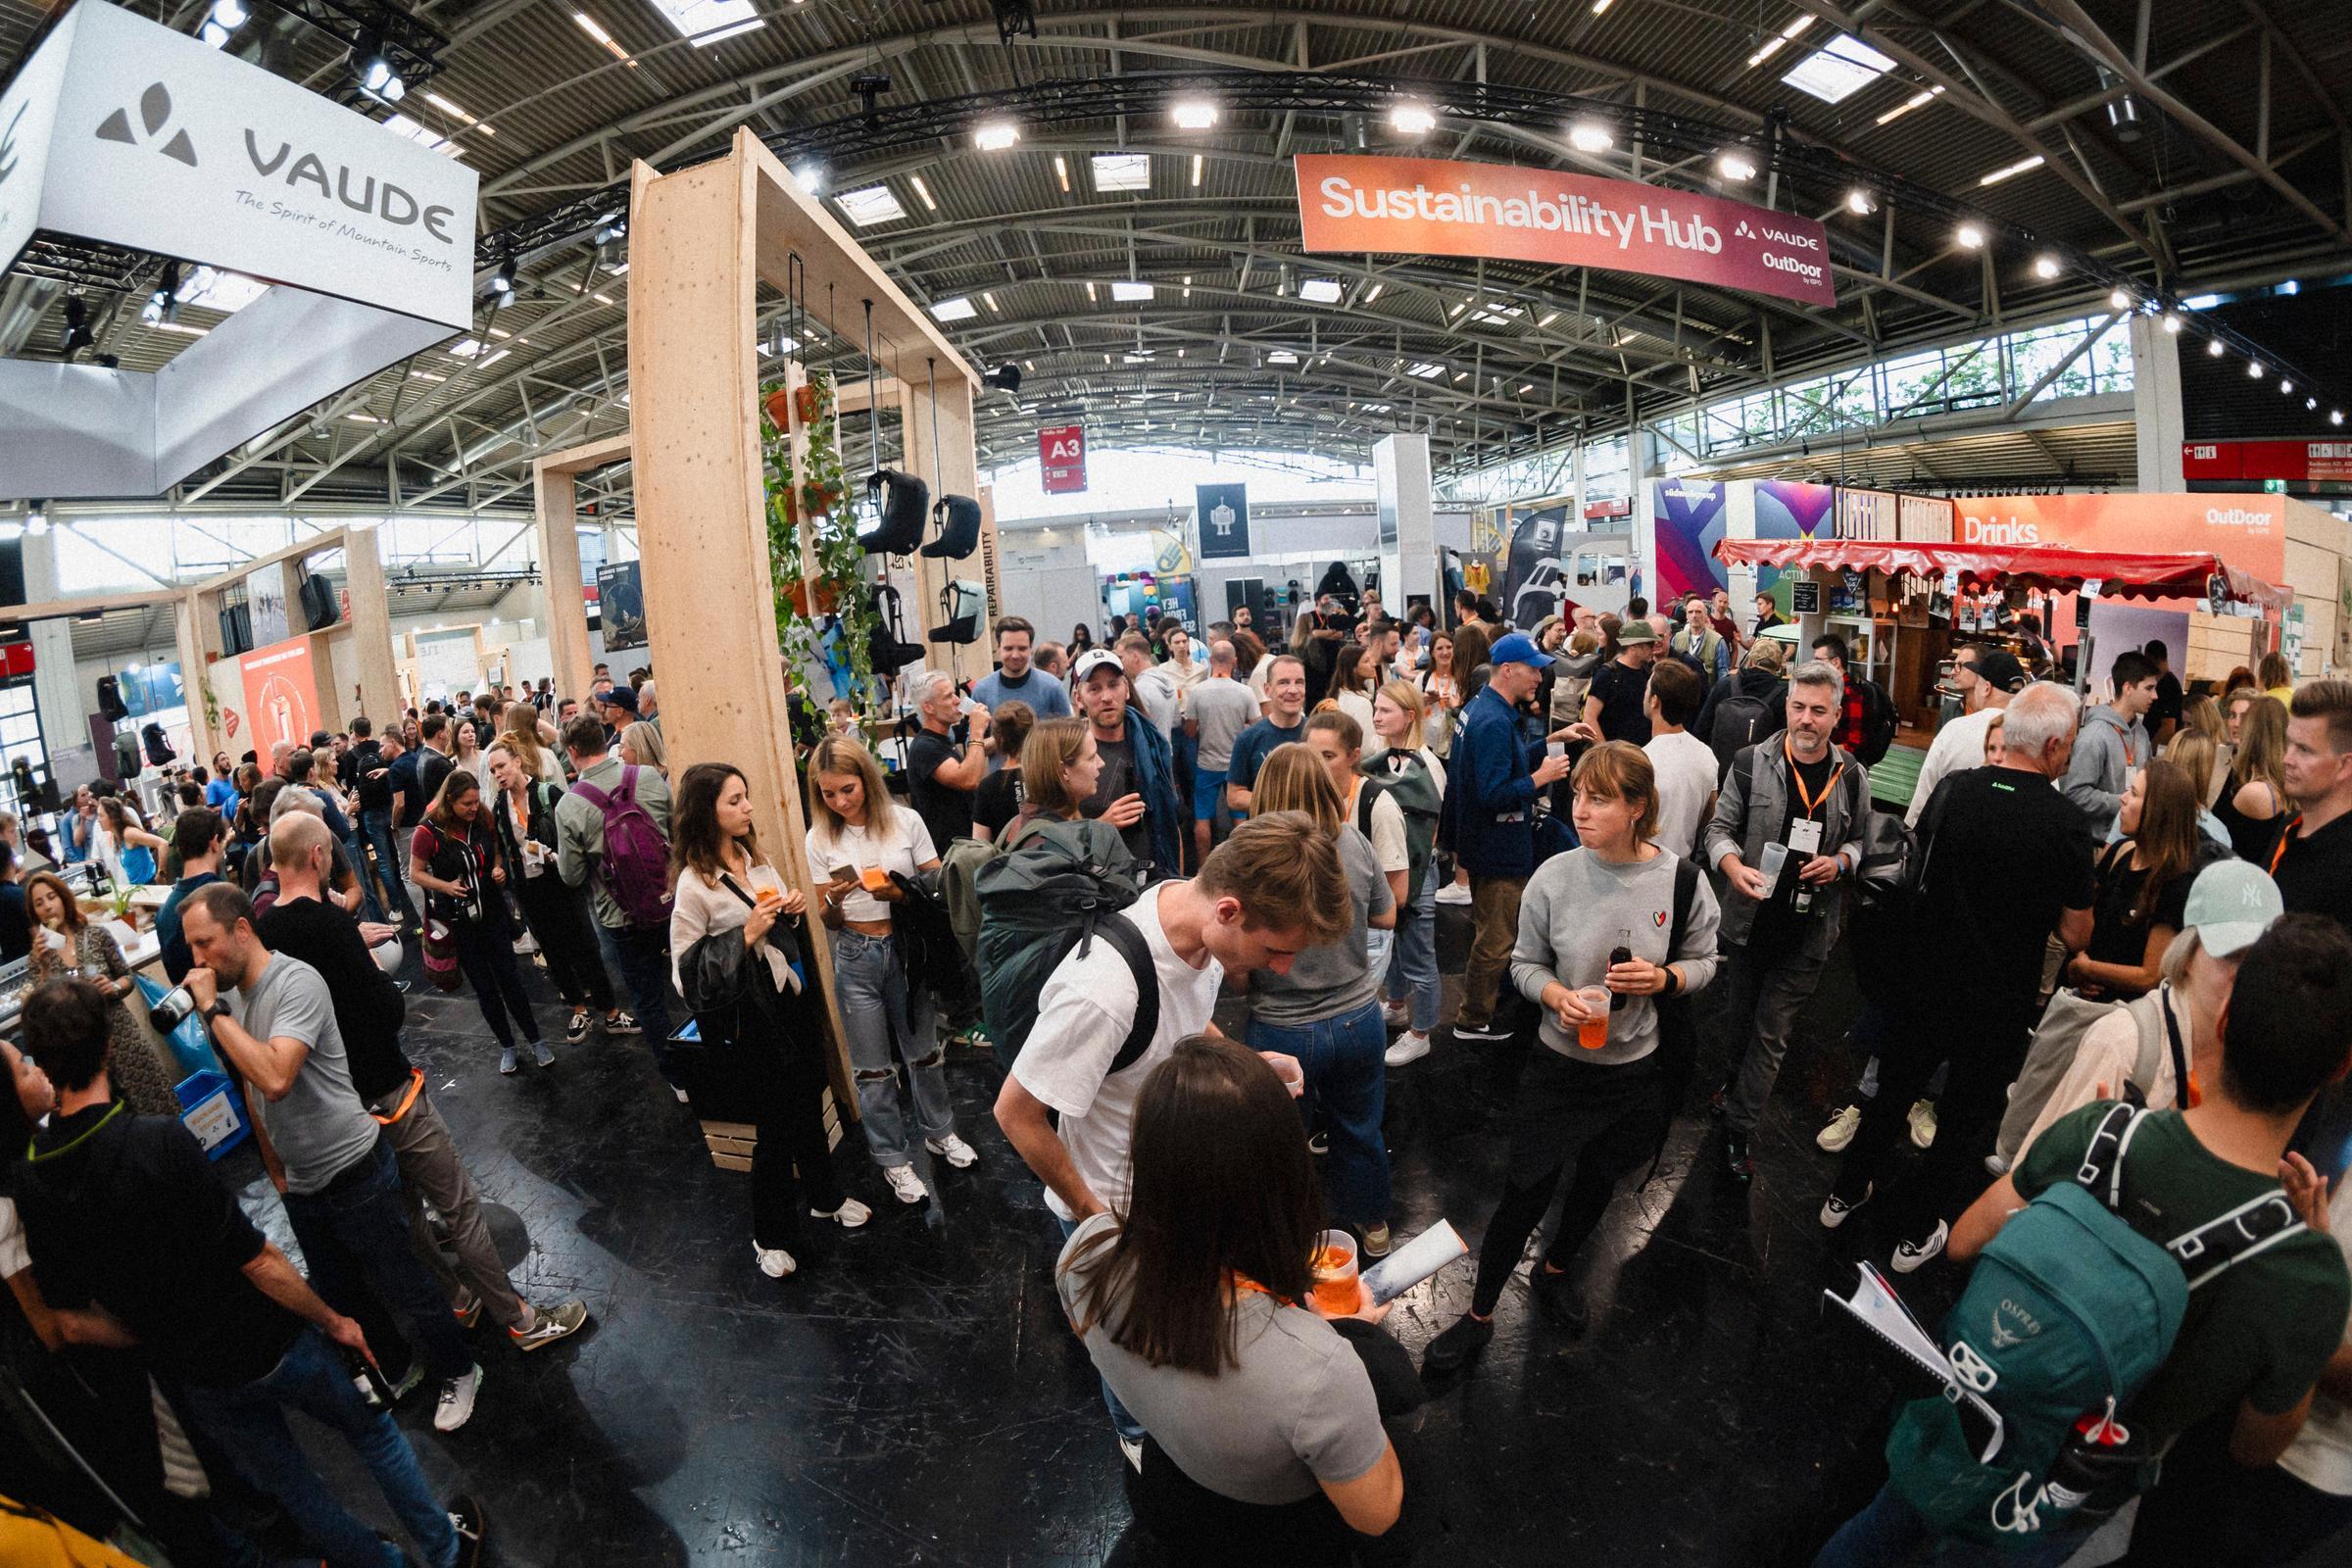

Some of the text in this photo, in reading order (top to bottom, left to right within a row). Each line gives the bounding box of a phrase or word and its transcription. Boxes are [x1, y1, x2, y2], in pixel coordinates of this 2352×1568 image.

[245, 127, 455, 245] VAUDE
[235, 189, 453, 272] The Spirit of Mountain Sports
[1320, 176, 1723, 255] Sustainability Hub
[1762, 227, 1819, 251] VAUDE
[1762, 252, 1822, 278] OutDoor
[1051, 438, 1081, 459] A3
[1964, 515, 2039, 545] Drinks
[2206, 508, 2273, 526] OutDoor
[981, 531, 999, 617] REPAIRABILITY
